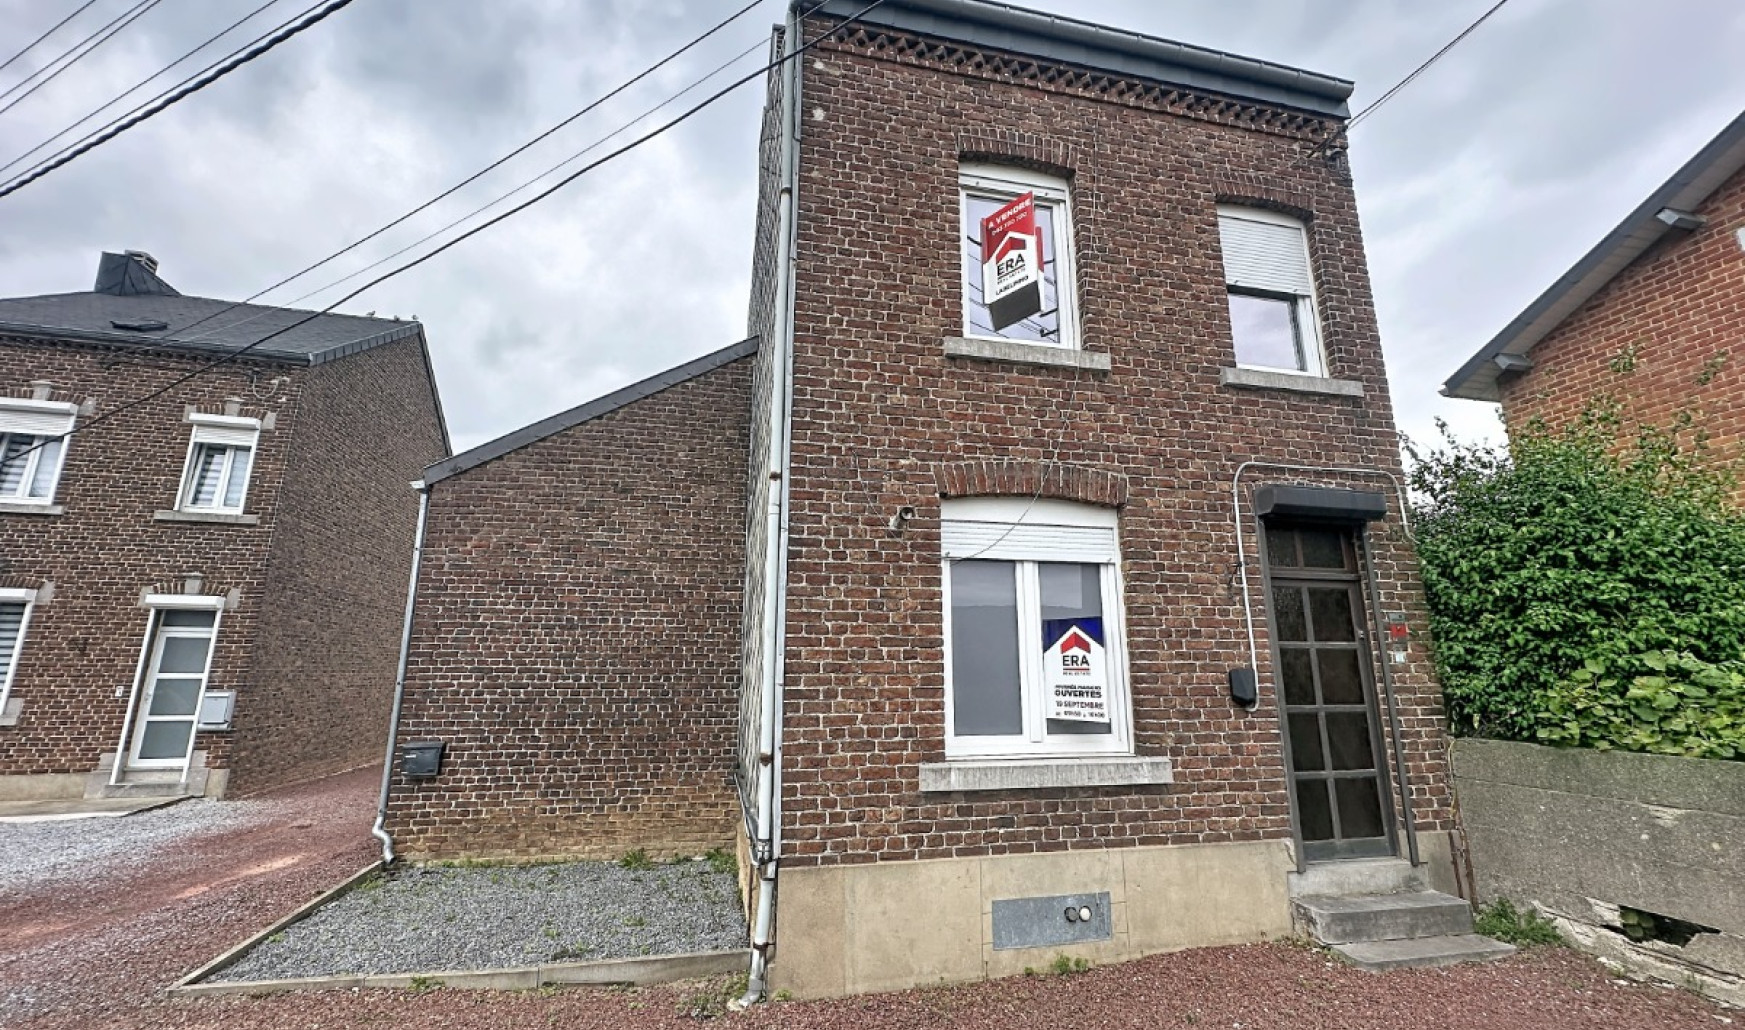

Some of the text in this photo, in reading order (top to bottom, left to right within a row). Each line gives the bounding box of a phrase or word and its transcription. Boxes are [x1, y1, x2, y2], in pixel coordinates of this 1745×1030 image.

[995, 198, 1031, 225] VENDRE
[996, 253, 1025, 276] ERA
[1062, 654, 1090, 667] ERA
[1054, 689, 1103, 699] OUVERTES
[1063, 700, 1104, 710] SEPTEMBRE
